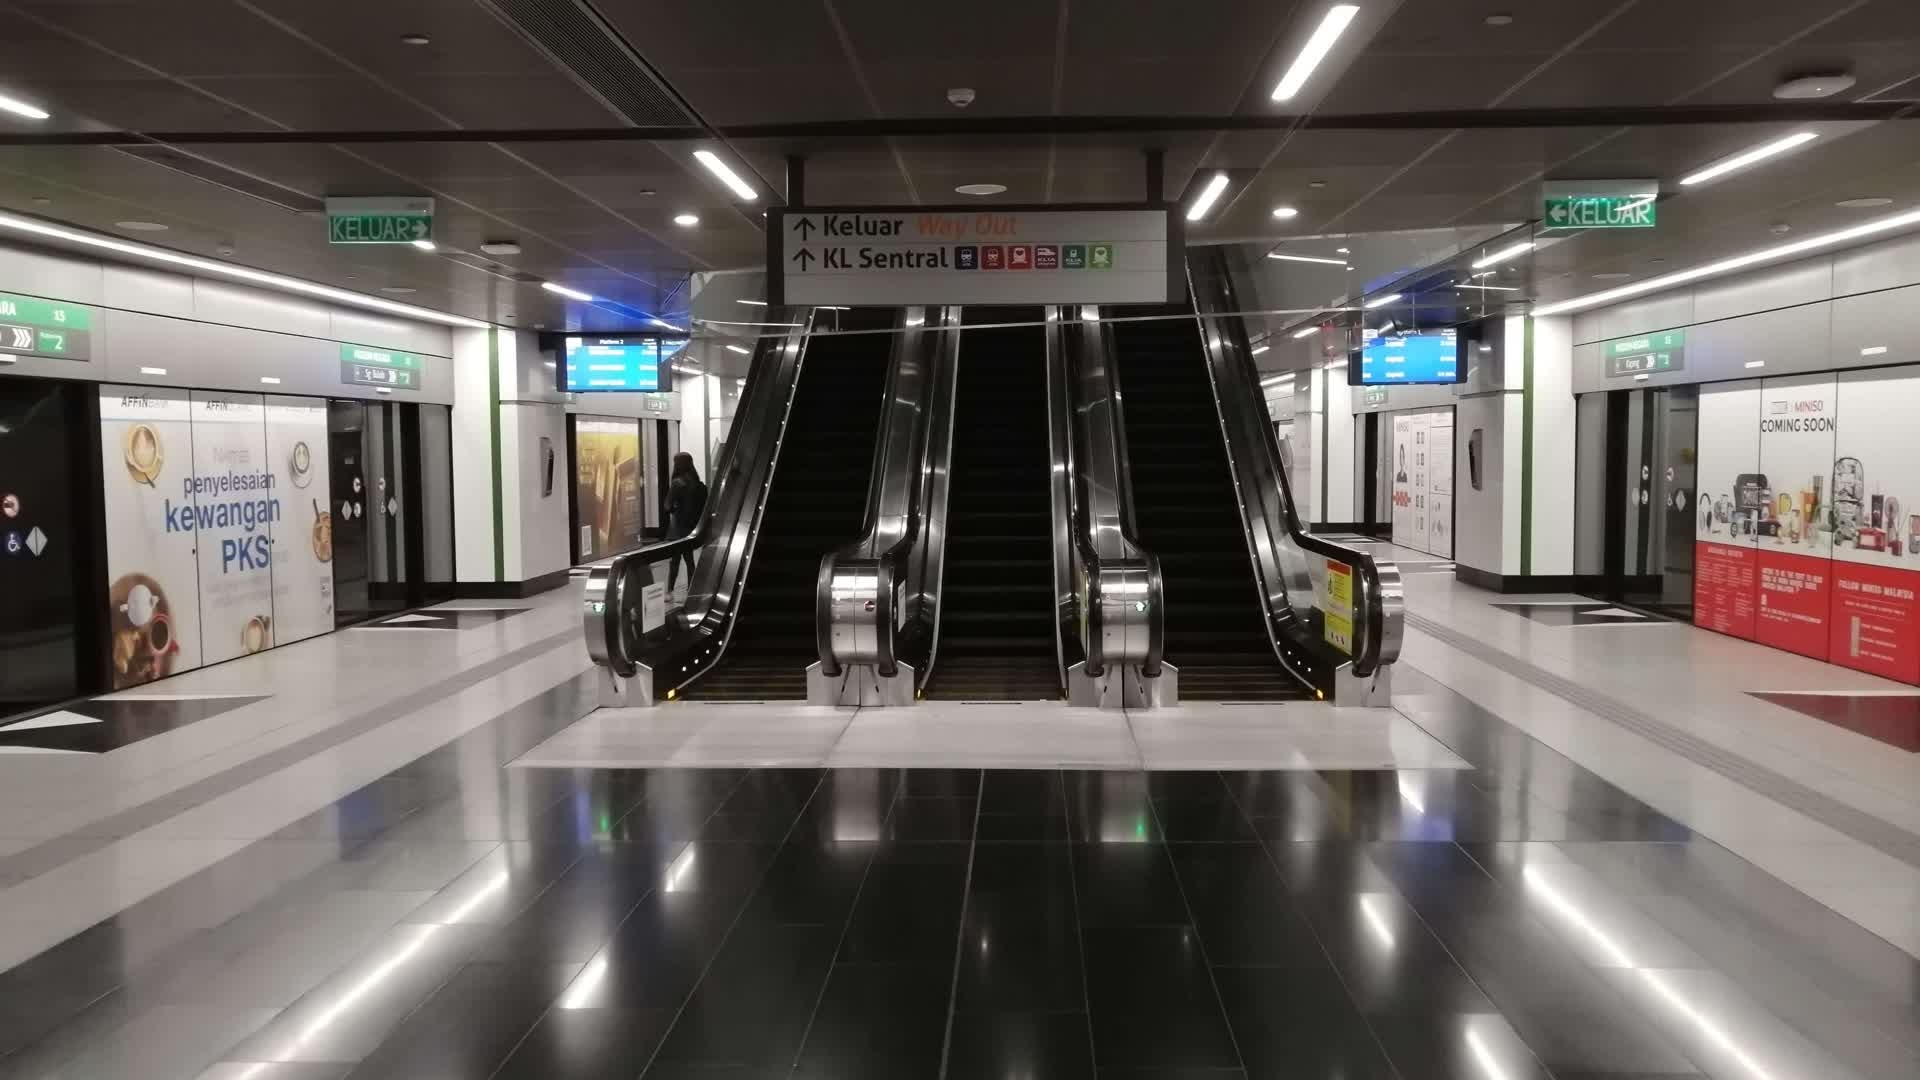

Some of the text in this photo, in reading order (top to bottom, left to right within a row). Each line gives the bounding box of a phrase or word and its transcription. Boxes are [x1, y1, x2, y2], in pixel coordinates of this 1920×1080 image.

[1568, 201, 1650, 224] KELUAR
[333, 216, 409, 241] KELUAR
[823, 216, 1018, 240] Keluar Way Out
[823, 249, 852, 269] KL
[858, 248, 948, 269] Sentral
[1794, 400, 1824, 413] MINISO
[1761, 417, 1835, 433] COMING SOON
[184, 469, 276, 499] penyelesaian
[165, 498, 281, 533] kewangan
[221, 535, 270, 574] PKS
